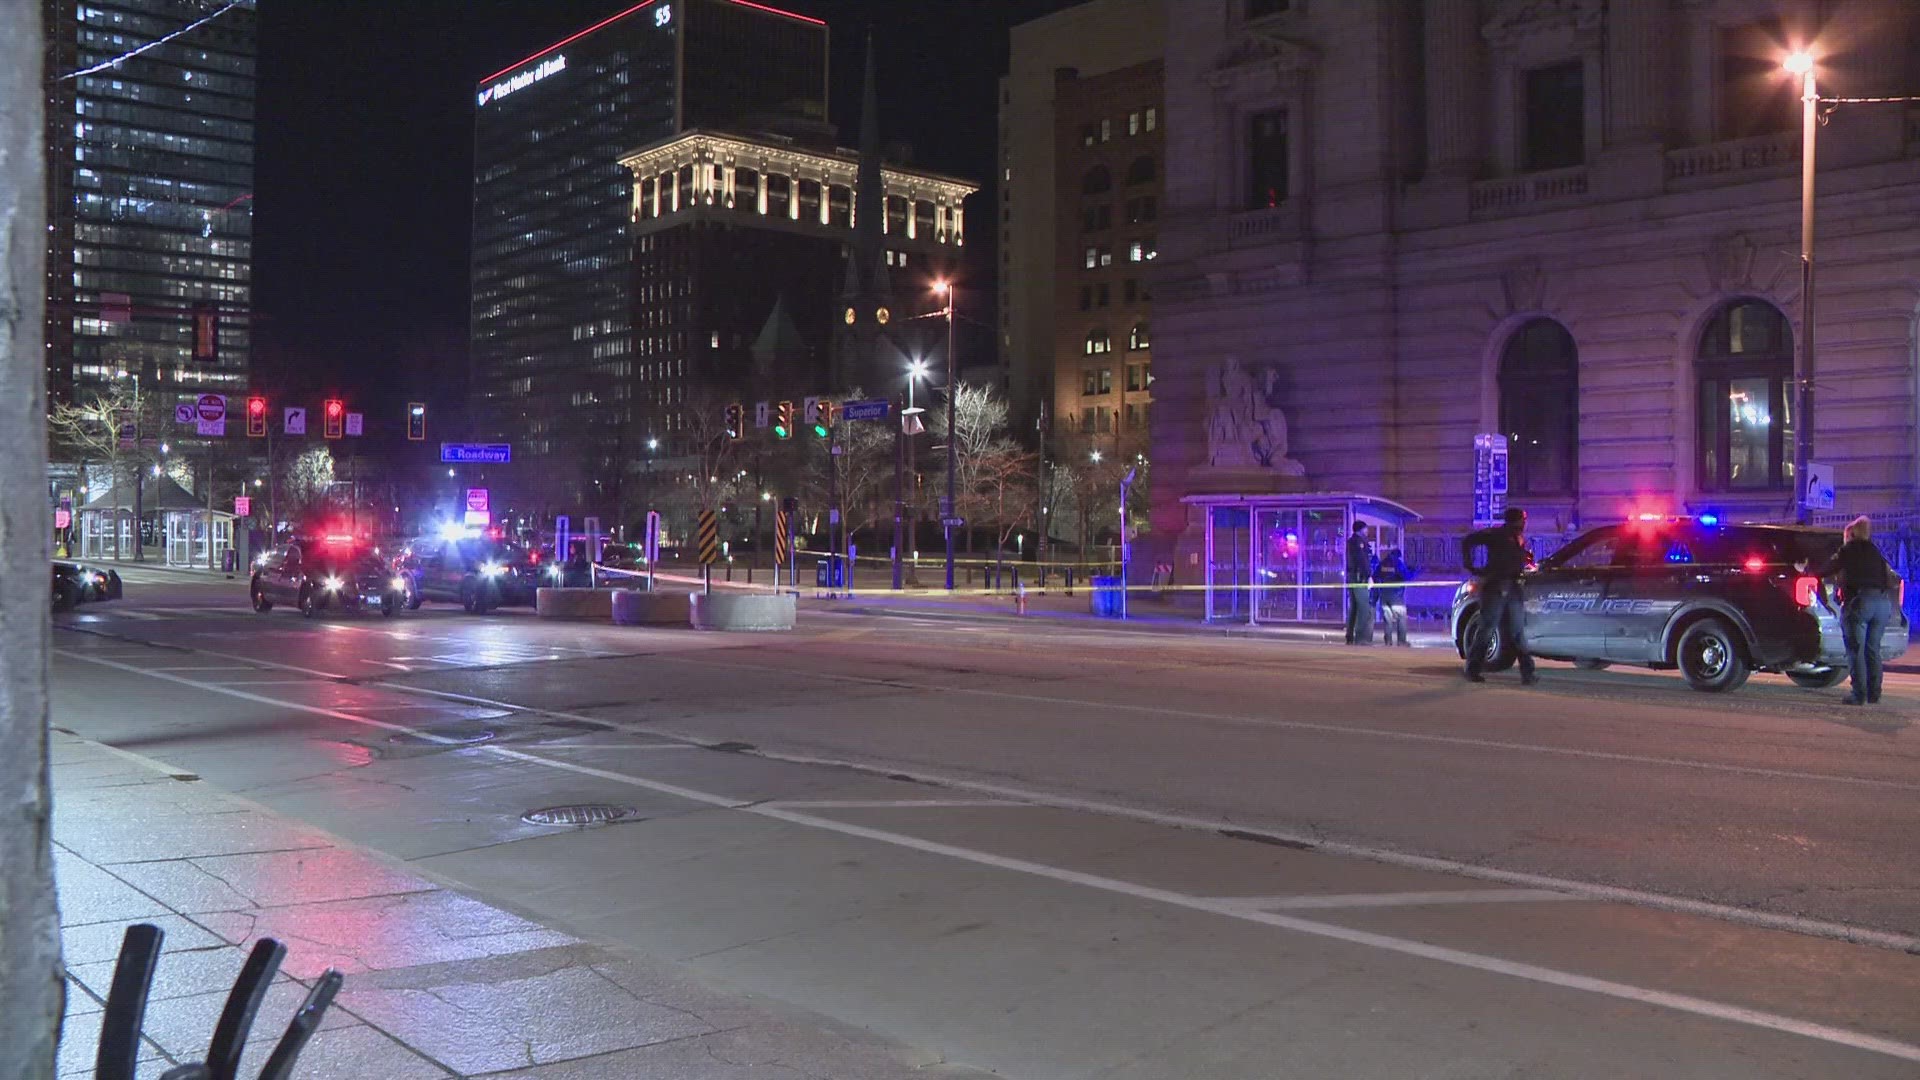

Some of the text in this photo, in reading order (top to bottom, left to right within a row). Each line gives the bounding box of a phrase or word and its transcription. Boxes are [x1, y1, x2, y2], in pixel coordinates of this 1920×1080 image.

[655, 4, 671, 27] 55
[493, 81, 511, 100] First
[544, 54, 566, 77] Bank
[849, 407, 882, 418] Superior
[444, 448, 506, 461] E. Roadway
[1543, 599, 1654, 614] POLICE
